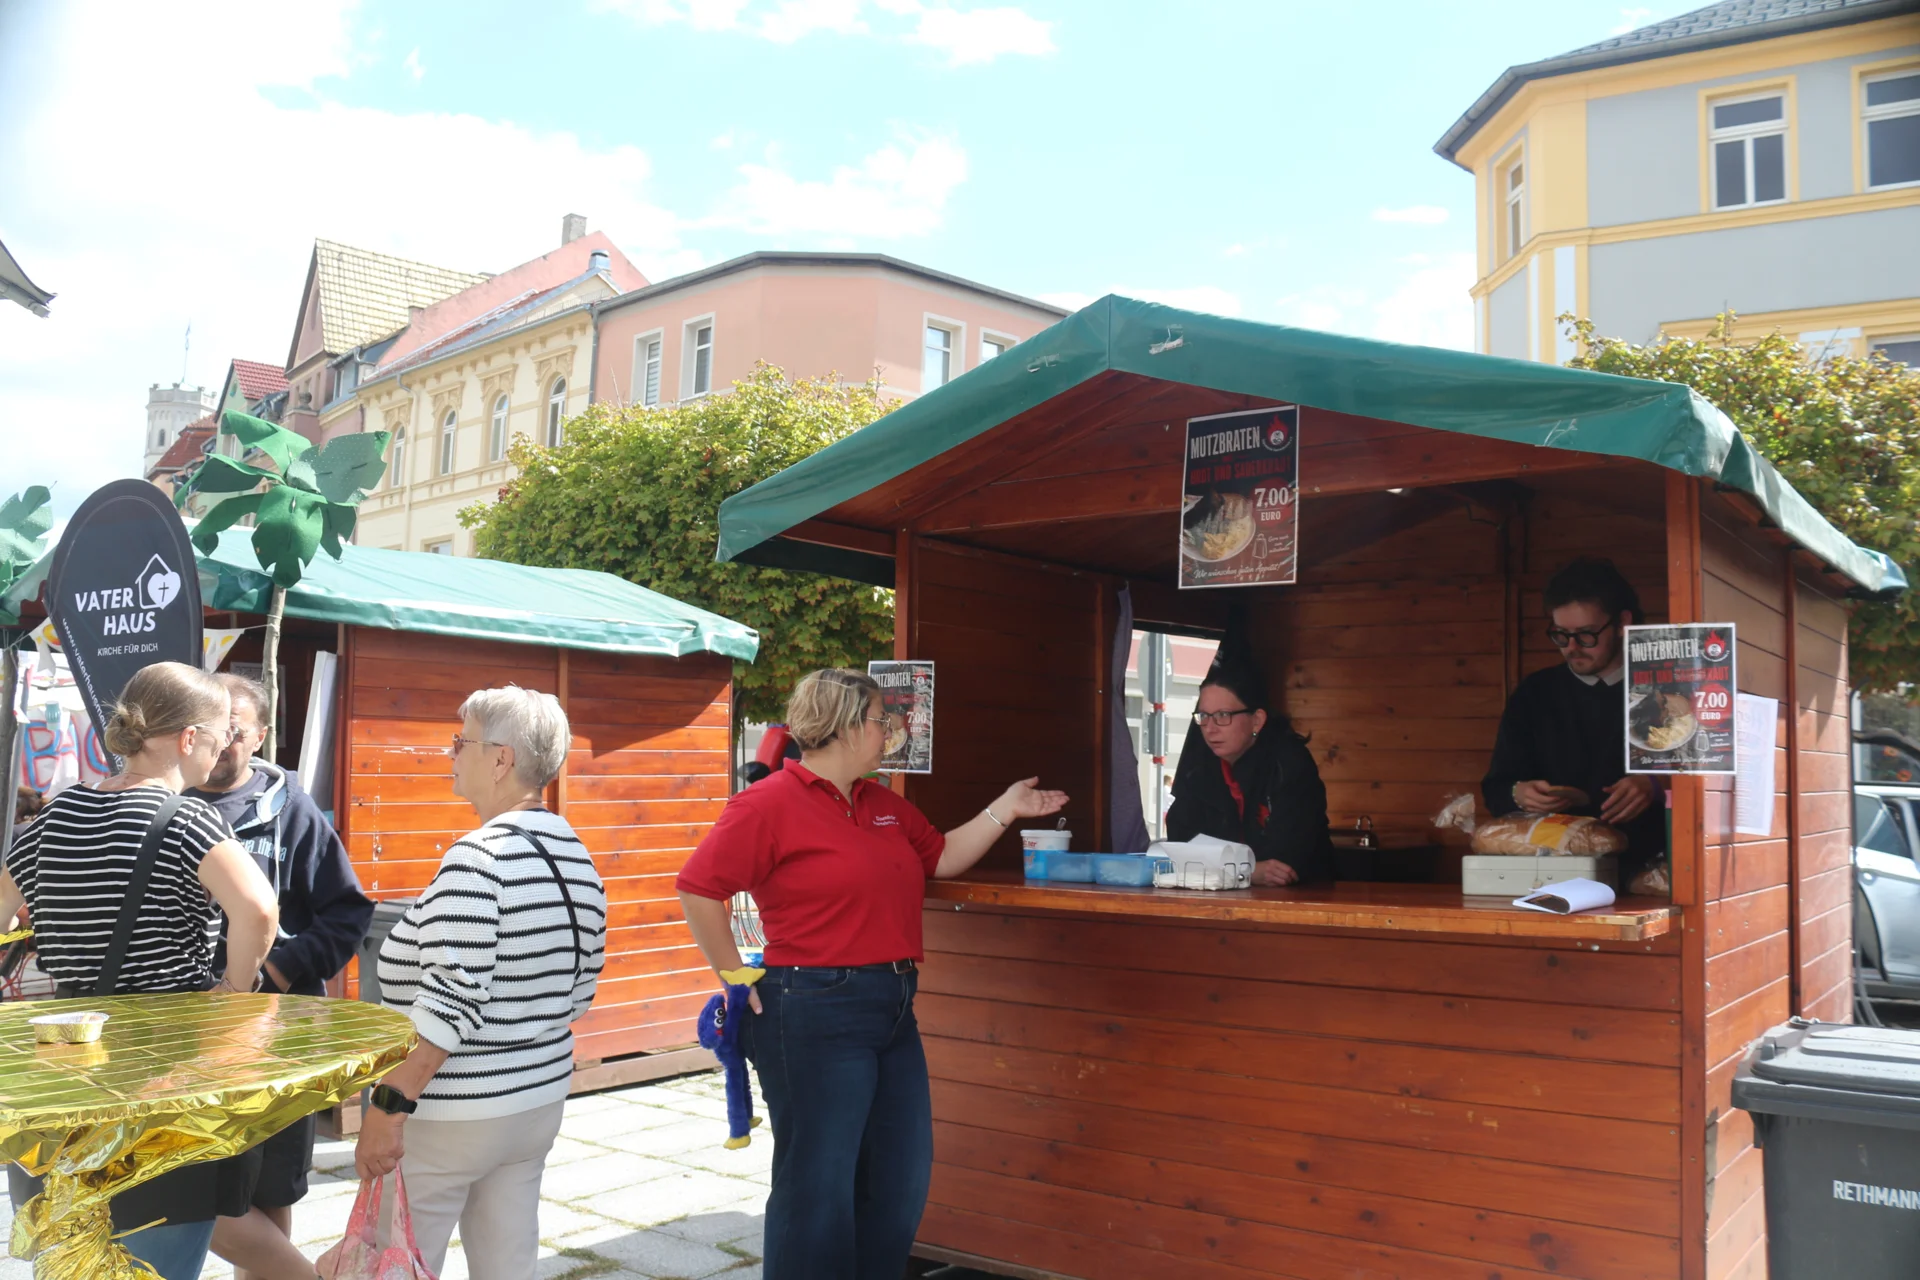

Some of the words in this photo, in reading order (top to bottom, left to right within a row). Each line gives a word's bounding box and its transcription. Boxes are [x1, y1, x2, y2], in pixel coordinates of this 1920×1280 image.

[1190, 426, 1260, 459] MUTZBRATEN
[1254, 487, 1289, 508] 7,00
[1260, 511, 1281, 521] EURO
[75, 587, 134, 613] VATER
[103, 611, 156, 636] HAUS
[97, 644, 123, 657] KIRCHE
[124, 642, 139, 654] FÜR
[141, 642, 159, 653] DICH
[1631, 638, 1699, 662] MUTZBRATEN
[1695, 692, 1728, 708] 7,00
[1701, 712, 1721, 720] EURO
[1833, 1179, 1920, 1210] RETHMANN
